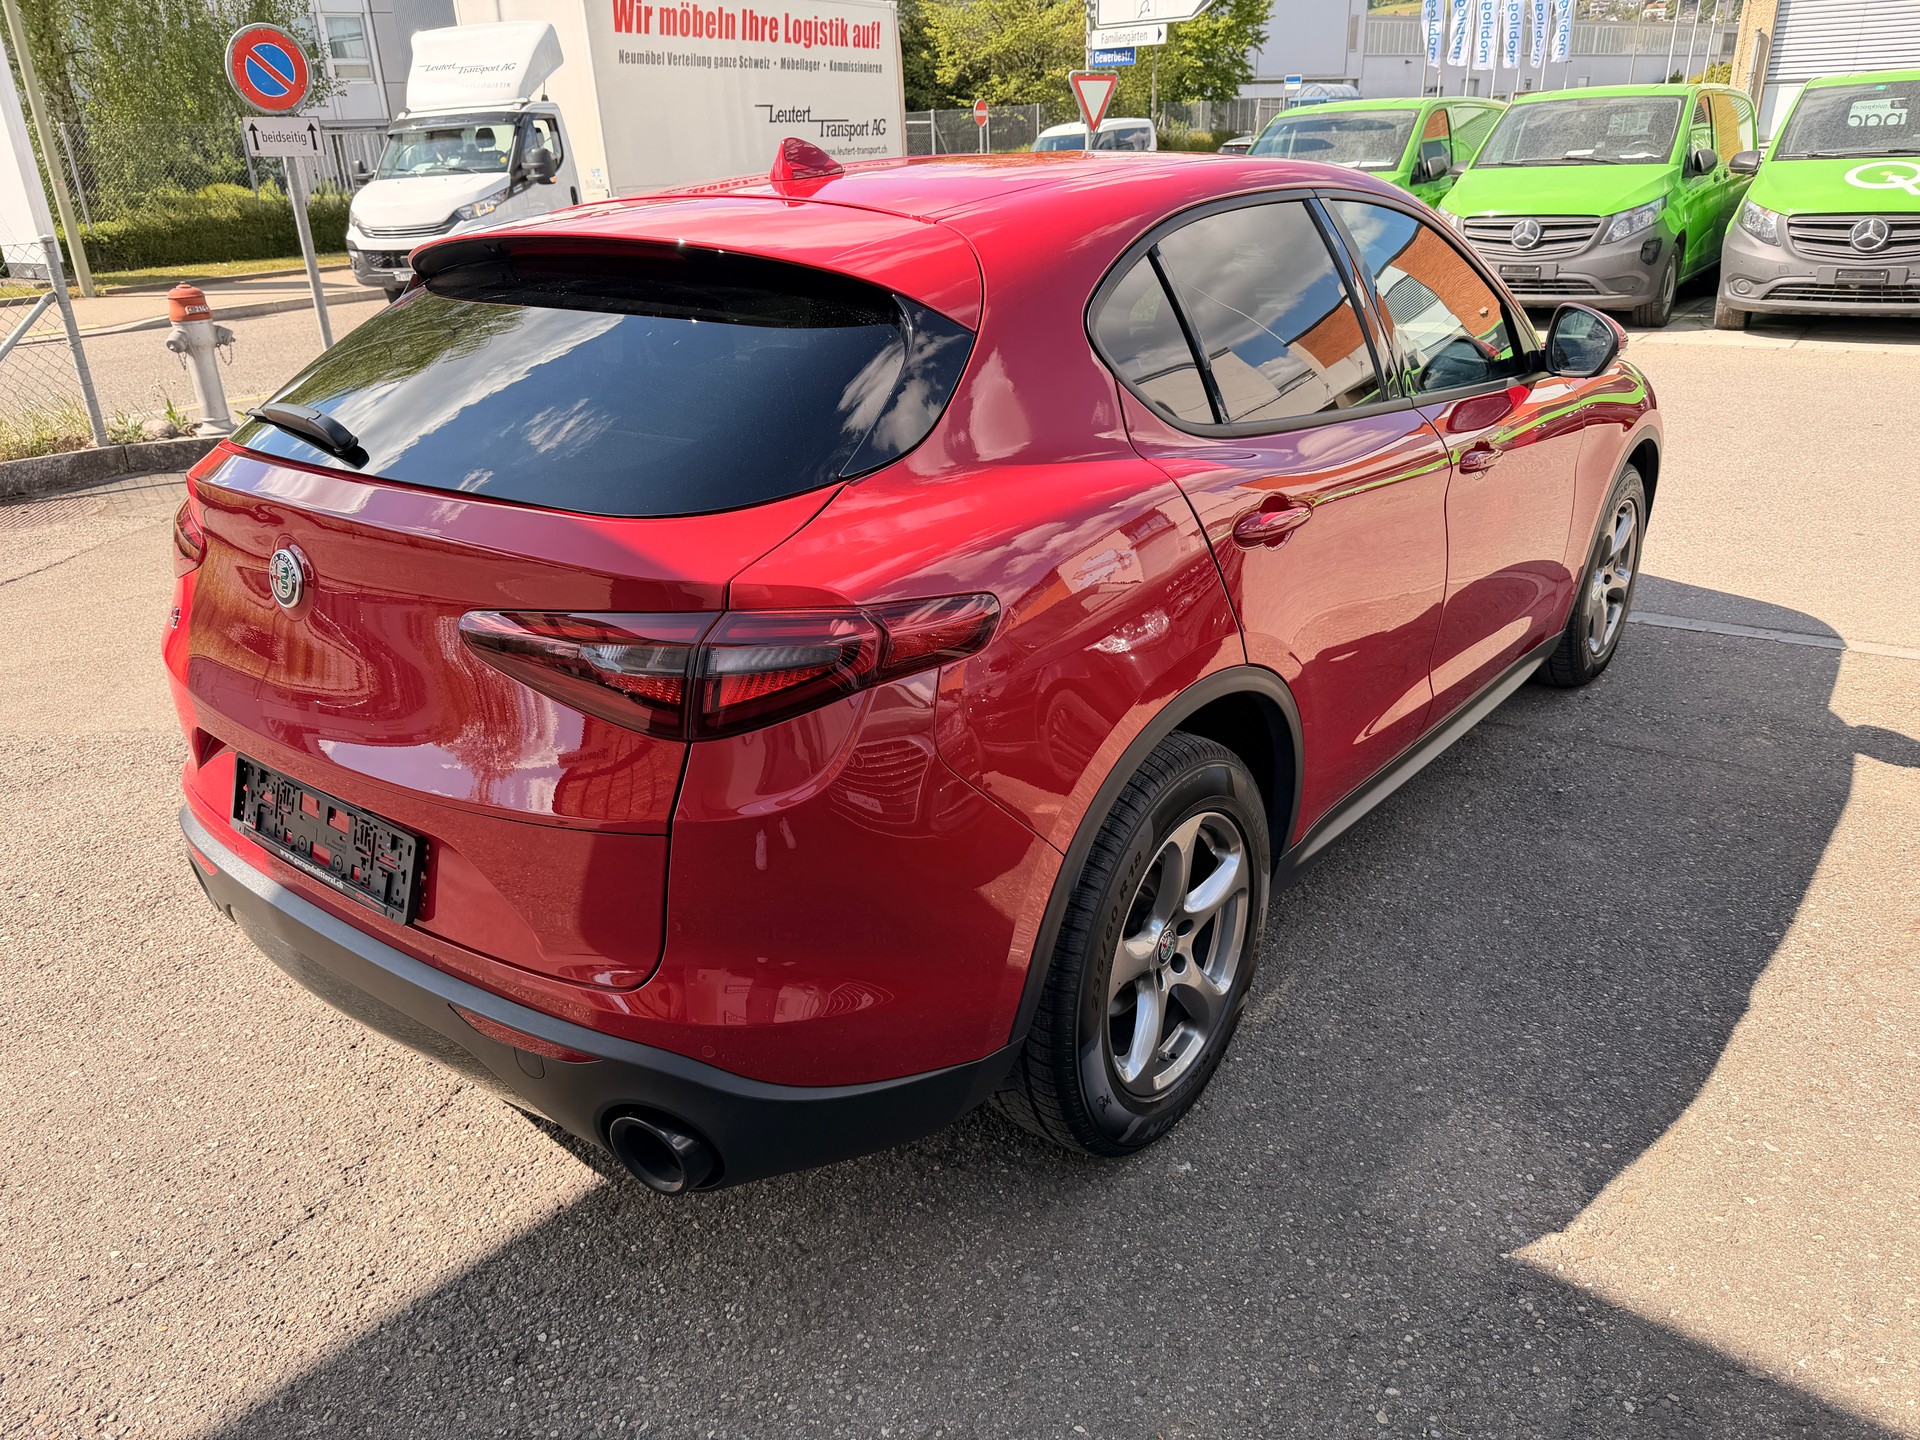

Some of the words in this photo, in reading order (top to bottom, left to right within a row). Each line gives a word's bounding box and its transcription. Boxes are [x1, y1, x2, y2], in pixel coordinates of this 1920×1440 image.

[613, 0, 652, 34] Wir
[659, 1, 736, 40] möbeln
[742, 8, 779, 43] Ihre
[784, 12, 848, 48] Logistik
[853, 20, 881, 49] auf!
[1101, 30, 1148, 45] Familiengärten
[618, 49, 665, 66] Neumöbel
[667, 52, 712, 69] Verteilung
[714, 56, 737, 69] ganze
[739, 55, 770, 70] Schweiz
[780, 57, 820, 72] Möbellager
[829, 60, 882, 73] Kommissionieren
[1095, 50, 1133, 64] Gewerbestr.
[425, 62, 456, 72] Leutert
[458, 64, 500, 74] Transport
[501, 62, 516, 71] AG
[769, 105, 811, 123] Leutert
[820, 119, 869, 141] Transport
[871, 118, 886, 136] AG
[261, 131, 307, 146] beidseitig
